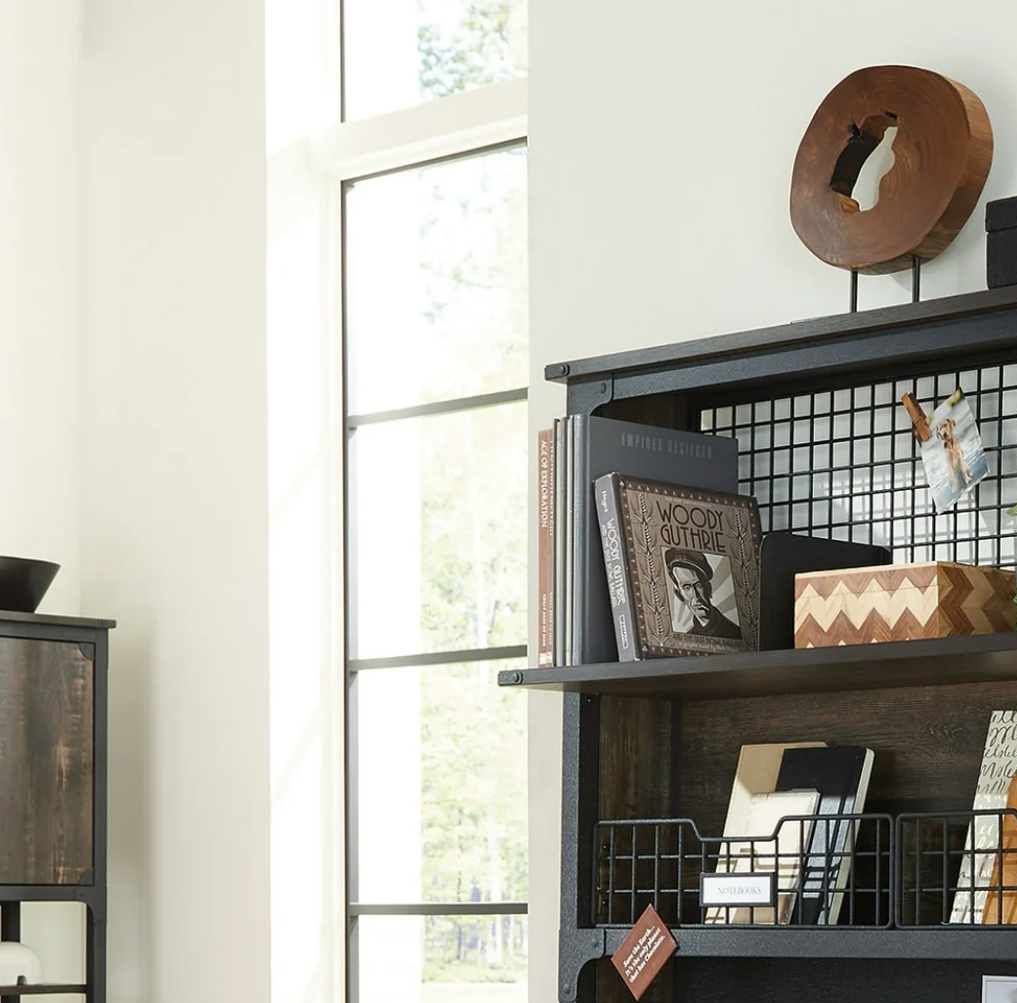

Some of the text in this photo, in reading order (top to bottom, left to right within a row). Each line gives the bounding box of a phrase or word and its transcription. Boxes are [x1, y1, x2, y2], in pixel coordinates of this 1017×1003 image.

[621, 432, 712, 459] EMPIRES BESIEGED
[541, 457, 548, 469] OF
[656, 501, 723, 531] WOODY
[660, 524, 726, 553] GUTHRIE
[606, 518, 620, 561] WOODY
[613, 564, 626, 606] GUTHRIE
[717, 886, 762, 895] NOTEBOOKS
[623, 953, 634, 967] Save
[632, 944, 640, 955] the
[632, 957, 641, 967] the
[639, 944, 649, 958] only
[647, 927, 661, 947] planet
[629, 970, 640, 983] that
[637, 960, 647, 972] has
